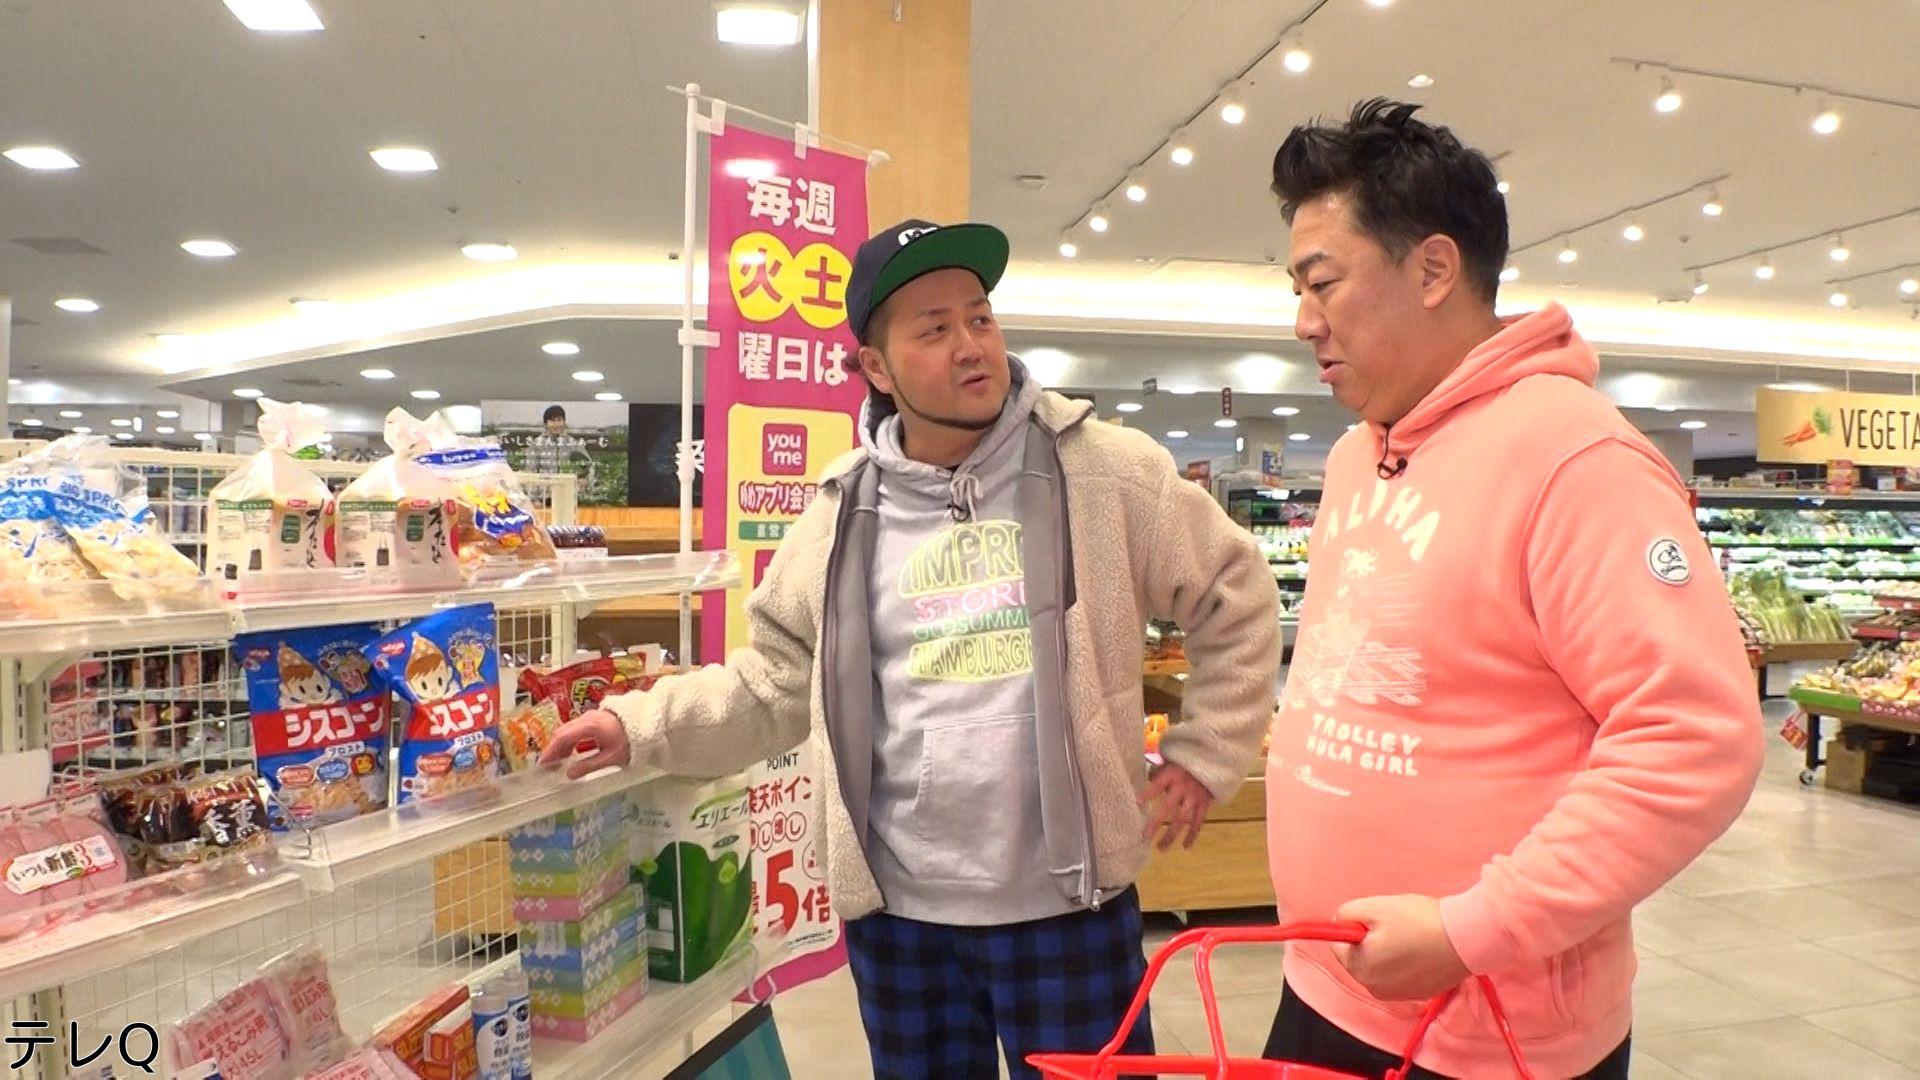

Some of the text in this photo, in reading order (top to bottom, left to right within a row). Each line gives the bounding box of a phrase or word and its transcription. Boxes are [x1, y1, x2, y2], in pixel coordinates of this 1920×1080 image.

[746, 176, 836, 235] 毎週
[738, 331, 848, 386] 曜日は
[767, 433, 801, 452] you
[772, 450, 802, 466] me
[284, 701, 384, 748] シスコーン
[1313, 713, 1421, 756] TROLLEY
[767, 752, 799, 772] POINT
[1306, 735, 1418, 777] HULA GIRL
